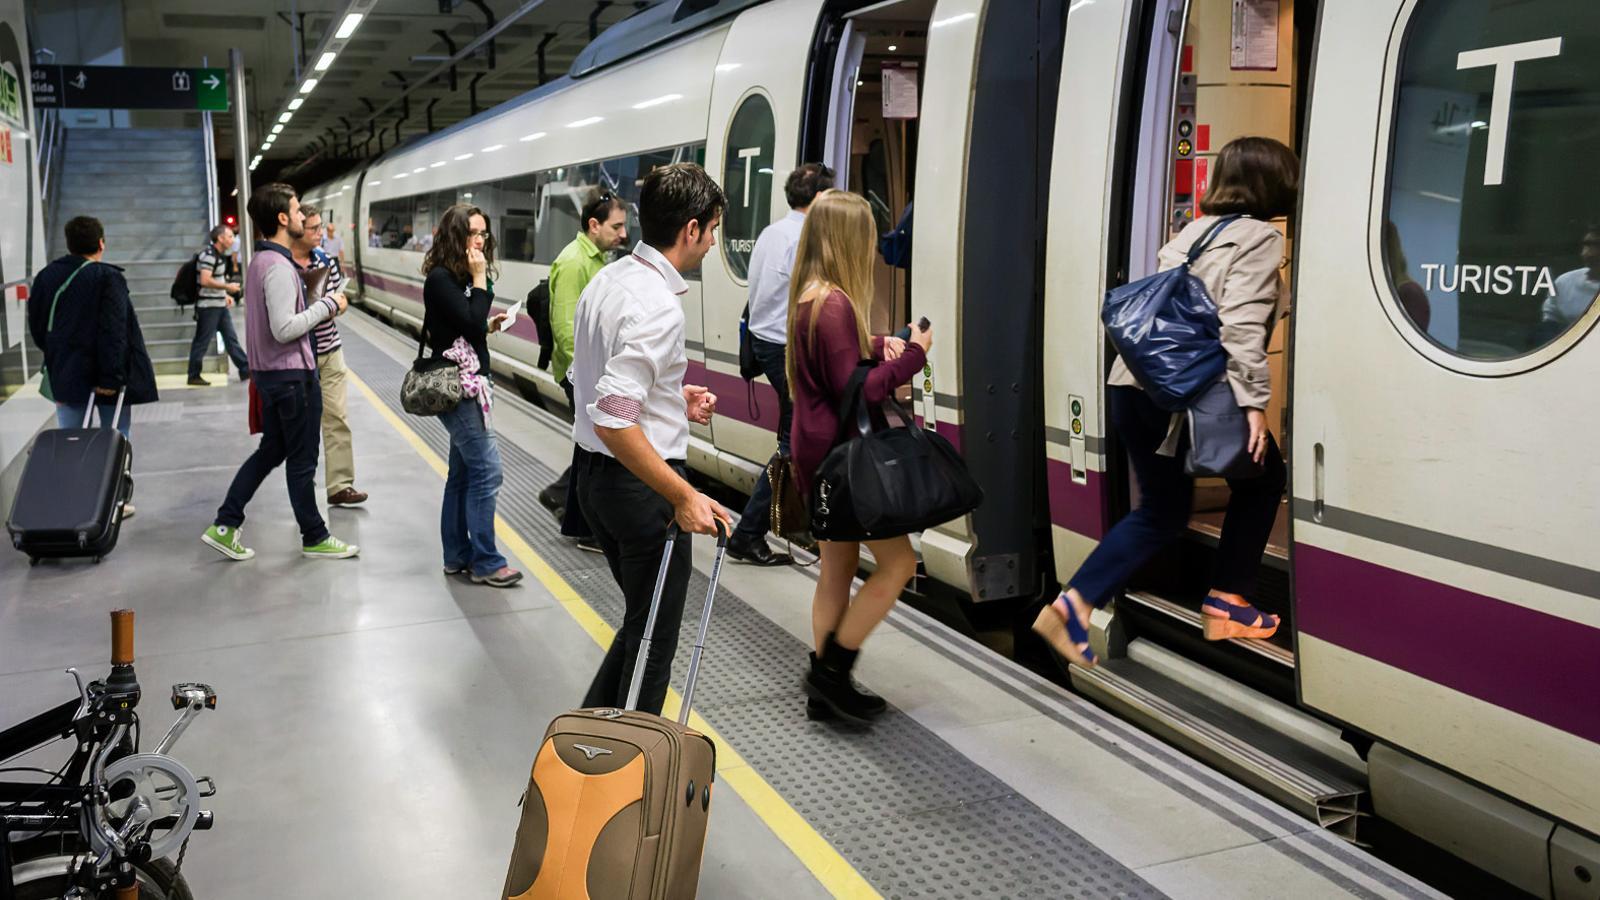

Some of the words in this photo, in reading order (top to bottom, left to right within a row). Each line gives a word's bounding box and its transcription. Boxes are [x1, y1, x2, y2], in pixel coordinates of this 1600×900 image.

[1456, 37, 1562, 186] T
[738, 147, 761, 207] T
[731, 239, 756, 252] TURIST
[1421, 263, 1556, 297] TURISTA
